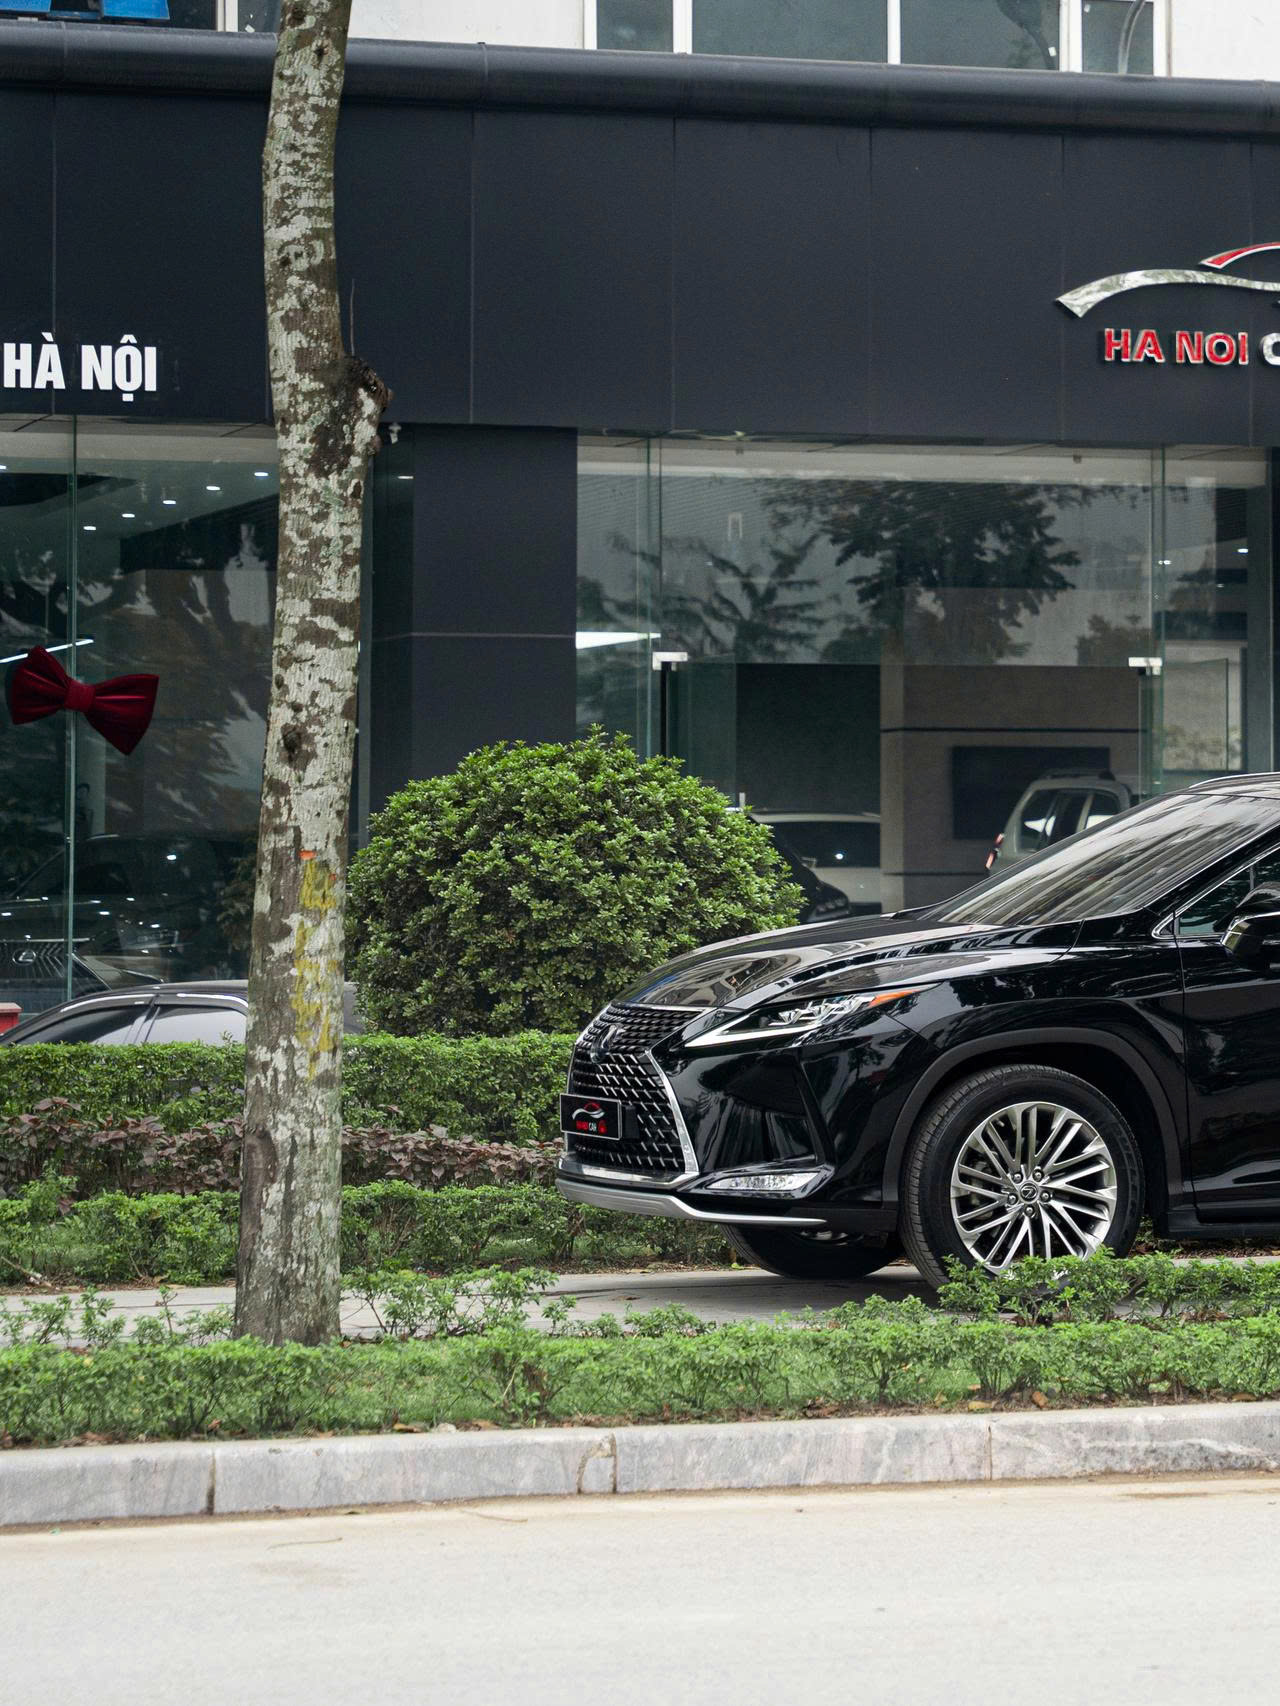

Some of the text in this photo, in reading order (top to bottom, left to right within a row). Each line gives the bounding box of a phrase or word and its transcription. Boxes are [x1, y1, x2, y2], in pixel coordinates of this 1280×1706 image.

[3, 332, 157, 402] HÀ NỘI
[1104, 328, 1165, 362] HA
[1175, 330, 1249, 365] NOI
